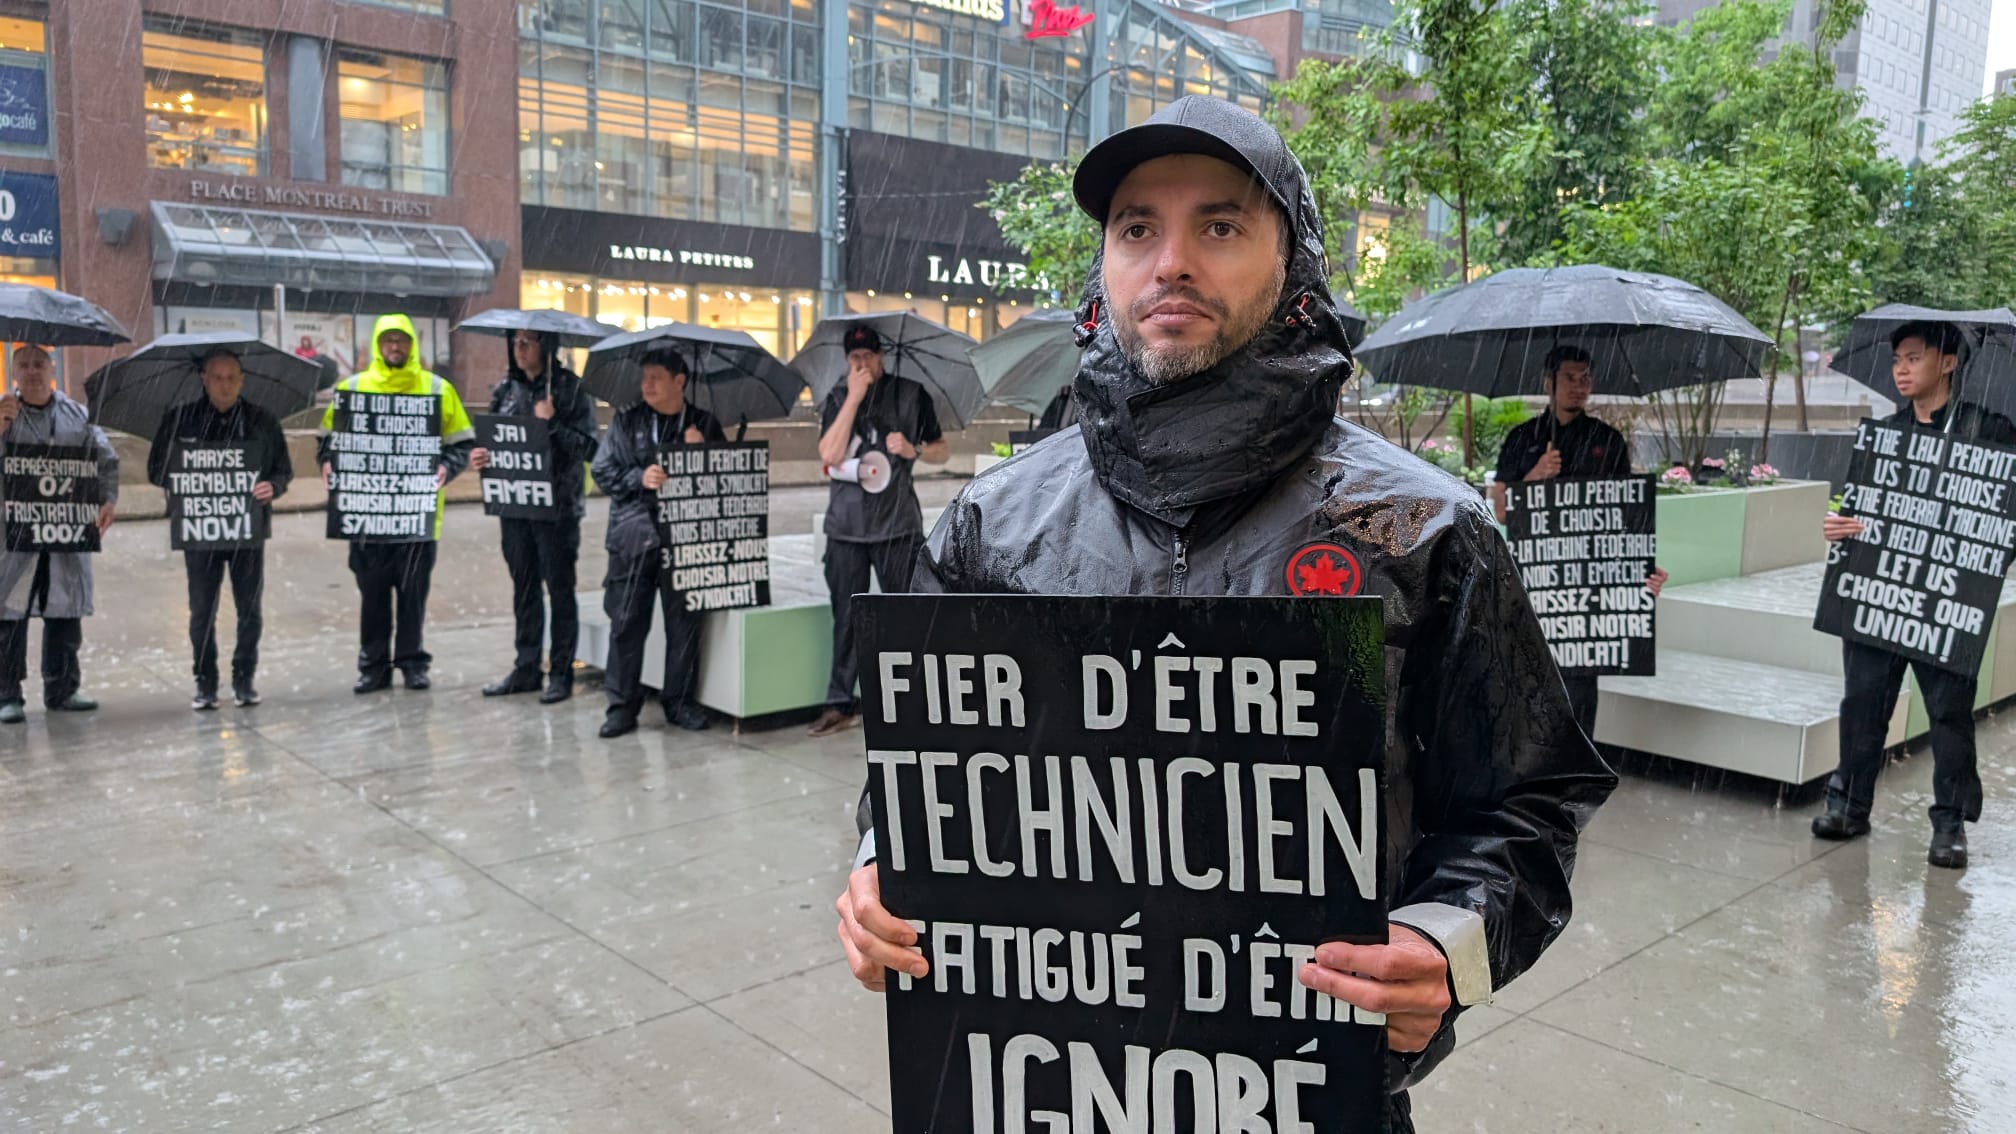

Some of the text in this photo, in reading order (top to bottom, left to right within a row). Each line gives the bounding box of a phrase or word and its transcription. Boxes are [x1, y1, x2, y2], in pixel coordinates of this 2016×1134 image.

[0, 112, 37, 131] ocafé
[191, 180, 256, 201] PLACE
[379, 198, 433, 217] TRUST
[1, 228, 54, 245] & café
[610, 245, 754, 269] LAURA PETITES
[350, 393, 365, 412] LA
[371, 395, 390, 414] LOI
[394, 396, 435, 416] PERMET
[352, 413, 369, 432] DE
[183, 449, 245, 469] MARYSE
[486, 450, 542, 471] HOISI
[686, 450, 704, 474] LOI
[709, 448, 752, 472] PERMET
[754, 447, 768, 470] DE
[1906, 432, 1945, 465] LAW
[338, 453, 367, 472] NOUS
[369, 455, 385, 473] EN
[1873, 458, 1902, 487] US
[1907, 463, 1931, 494] TO
[38, 475, 74, 497] 0%
[169, 471, 260, 495] TREMBLAY
[482, 478, 553, 507] AMFA
[696, 475, 717, 496] SON
[1526, 484, 1546, 509] LA
[1554, 482, 1580, 507] LOI
[1585, 479, 1646, 505] PERMET
[5, 501, 99, 524] FRUSTRATION
[183, 496, 246, 517] RESIGN
[337, 493, 437, 514] CHOISIR NOTRE
[680, 497, 720, 520] MACHINE
[182, 513, 253, 542] NOW!
[341, 512, 427, 537] SYNDICAT!
[670, 521, 698, 545] NOUS
[701, 520, 715, 541] EN
[1531, 511, 1550, 535] DE
[1882, 490, 1943, 530] FEDERAL
[1944, 505, 2016, 549] MACHINE
[31, 523, 86, 544] 100%
[1886, 522, 1930, 556] HELD
[1930, 533, 1957, 564] US
[1535, 535, 1591, 562] MACHINE
[672, 560, 769, 591] CHOISIR NOTRE
[1523, 564, 1559, 589] NOUS
[1564, 562, 1582, 586] EN
[1876, 550, 1922, 585] LET
[1925, 563, 1959, 597] US
[685, 580, 757, 612] SYNDICAT!
[1529, 586, 1655, 613] AISSEZ-NOUS
[1836, 572, 1985, 635] CHOOSE OUR
[1540, 613, 1653, 640] OISIR NOTRE
[1853, 604, 1956, 664] UNION!
[1550, 638, 1629, 669] NDICAT!
[879, 632, 1319, 737] FIER D'ÊTRE
[867, 750, 1377, 900] TECHNICIEN
[1184, 922, 1387, 1026] D'ÊT
[967, 1032, 1327, 1134] IGNORÉ
